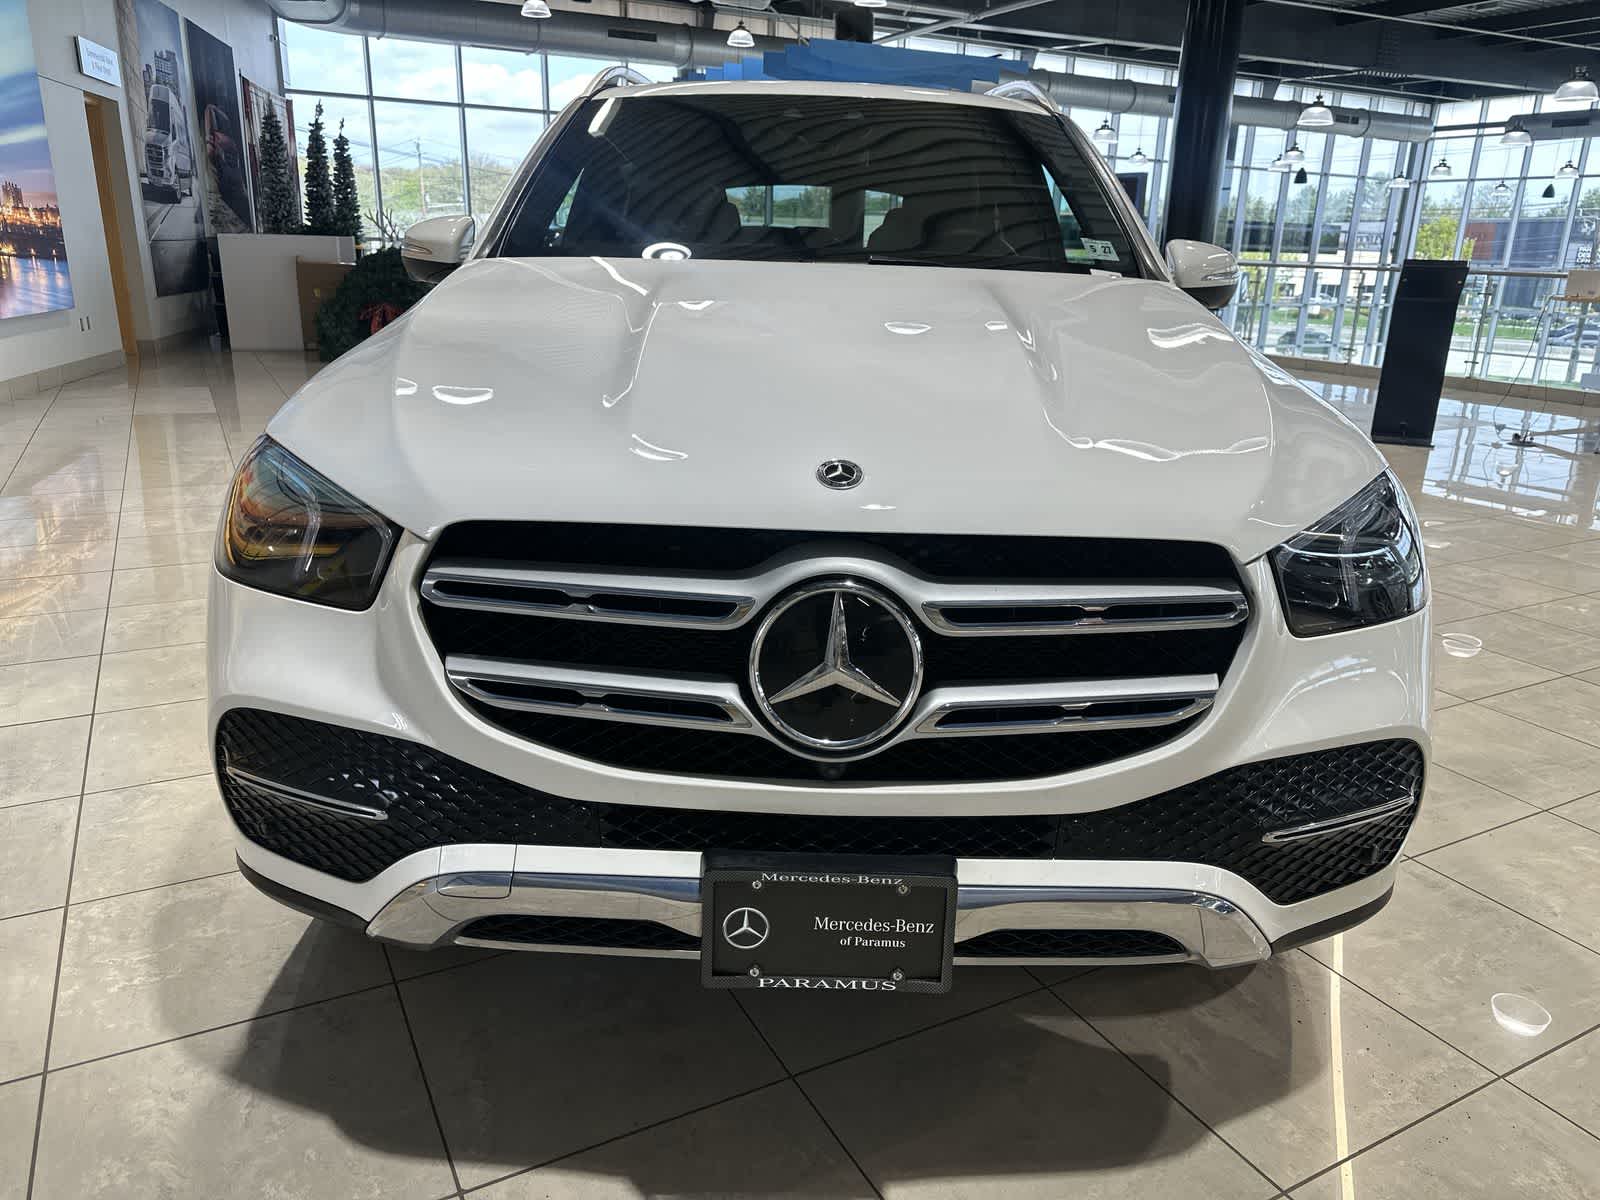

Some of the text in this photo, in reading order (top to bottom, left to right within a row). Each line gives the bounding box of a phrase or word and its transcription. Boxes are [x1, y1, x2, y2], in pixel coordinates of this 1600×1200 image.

[761, 872, 903, 885] Mercedes-Benz
[813, 916, 935, 934] Mercedes-Benz
[840, 936, 906, 948] of Paramus
[758, 978, 897, 991] PARAMUS
